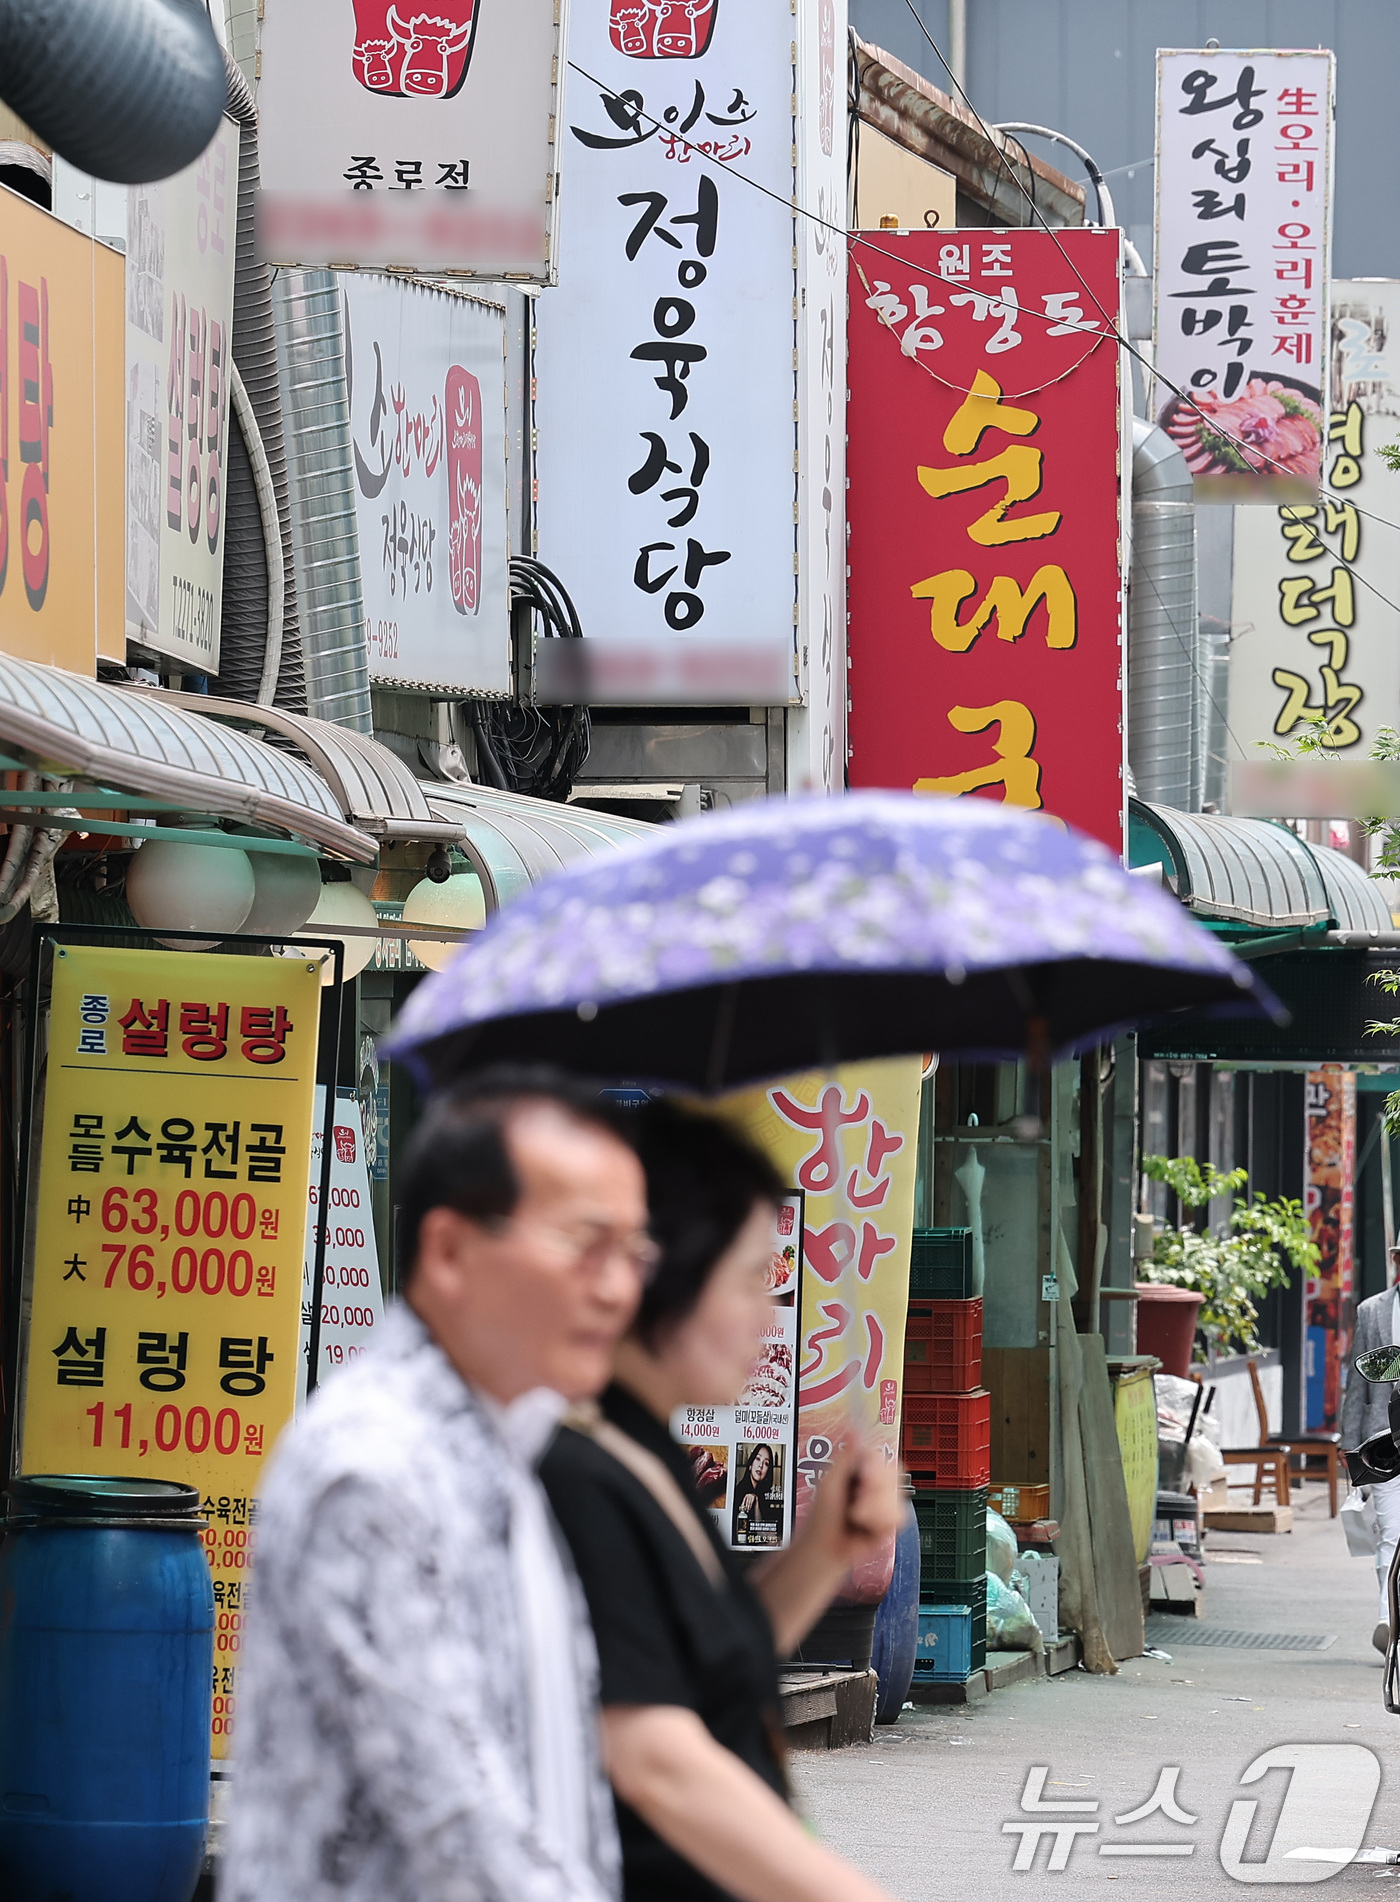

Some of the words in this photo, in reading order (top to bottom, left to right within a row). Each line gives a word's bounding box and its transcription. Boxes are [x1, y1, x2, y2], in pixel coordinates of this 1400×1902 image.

[658, 134, 751, 163] 한마리
[938, 244, 1013, 281] 원조
[865, 280, 1101, 357] 함경도
[167, 290, 227, 556] 설렁탕
[391, 380, 444, 478] 한마리
[617, 174, 731, 630] 정육식당
[381, 500, 436, 601] 정육식당
[364, 618, 399, 659] 9-9252
[77, 994, 109, 1055] 종로
[117, 998, 293, 1064] 설렁탕
[68, 1114, 105, 1173] 모듬
[111, 1116, 286, 1183] 수육전골
[68, 1194, 91, 1224] 中
[101, 1186, 280, 1241] 63,000원
[309, 1186, 359, 1208] 6,000
[63, 1252, 88, 1282] 大
[101, 1244, 277, 1298] 76,000원
[771, 1086, 904, 1406] 한마리
[322, 1265, 369, 1288] 0,000
[321, 1304, 373, 1328] 20,000
[52, 1326, 274, 1396] 설렁탕
[86, 1402, 265, 1458] 11,000원
[681, 1423, 720, 1438] 14,000원
[743, 1426, 779, 1440] 16,000원
[686, 1408, 715, 1423] 항정살
